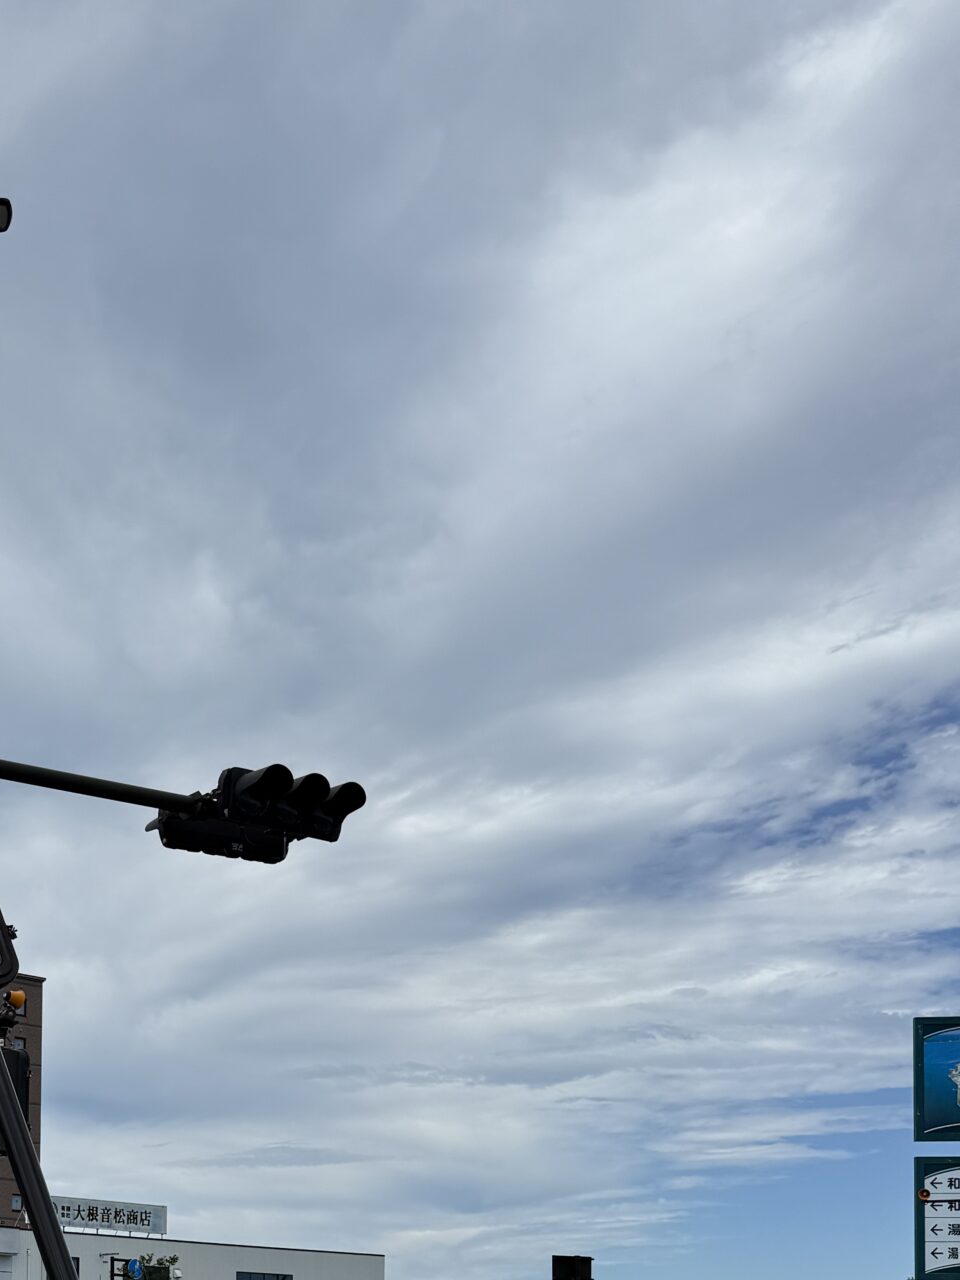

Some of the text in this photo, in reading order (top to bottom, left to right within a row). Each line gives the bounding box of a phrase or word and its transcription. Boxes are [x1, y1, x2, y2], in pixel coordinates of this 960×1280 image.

[73, 1204, 152, 1227] 大根音松商店
